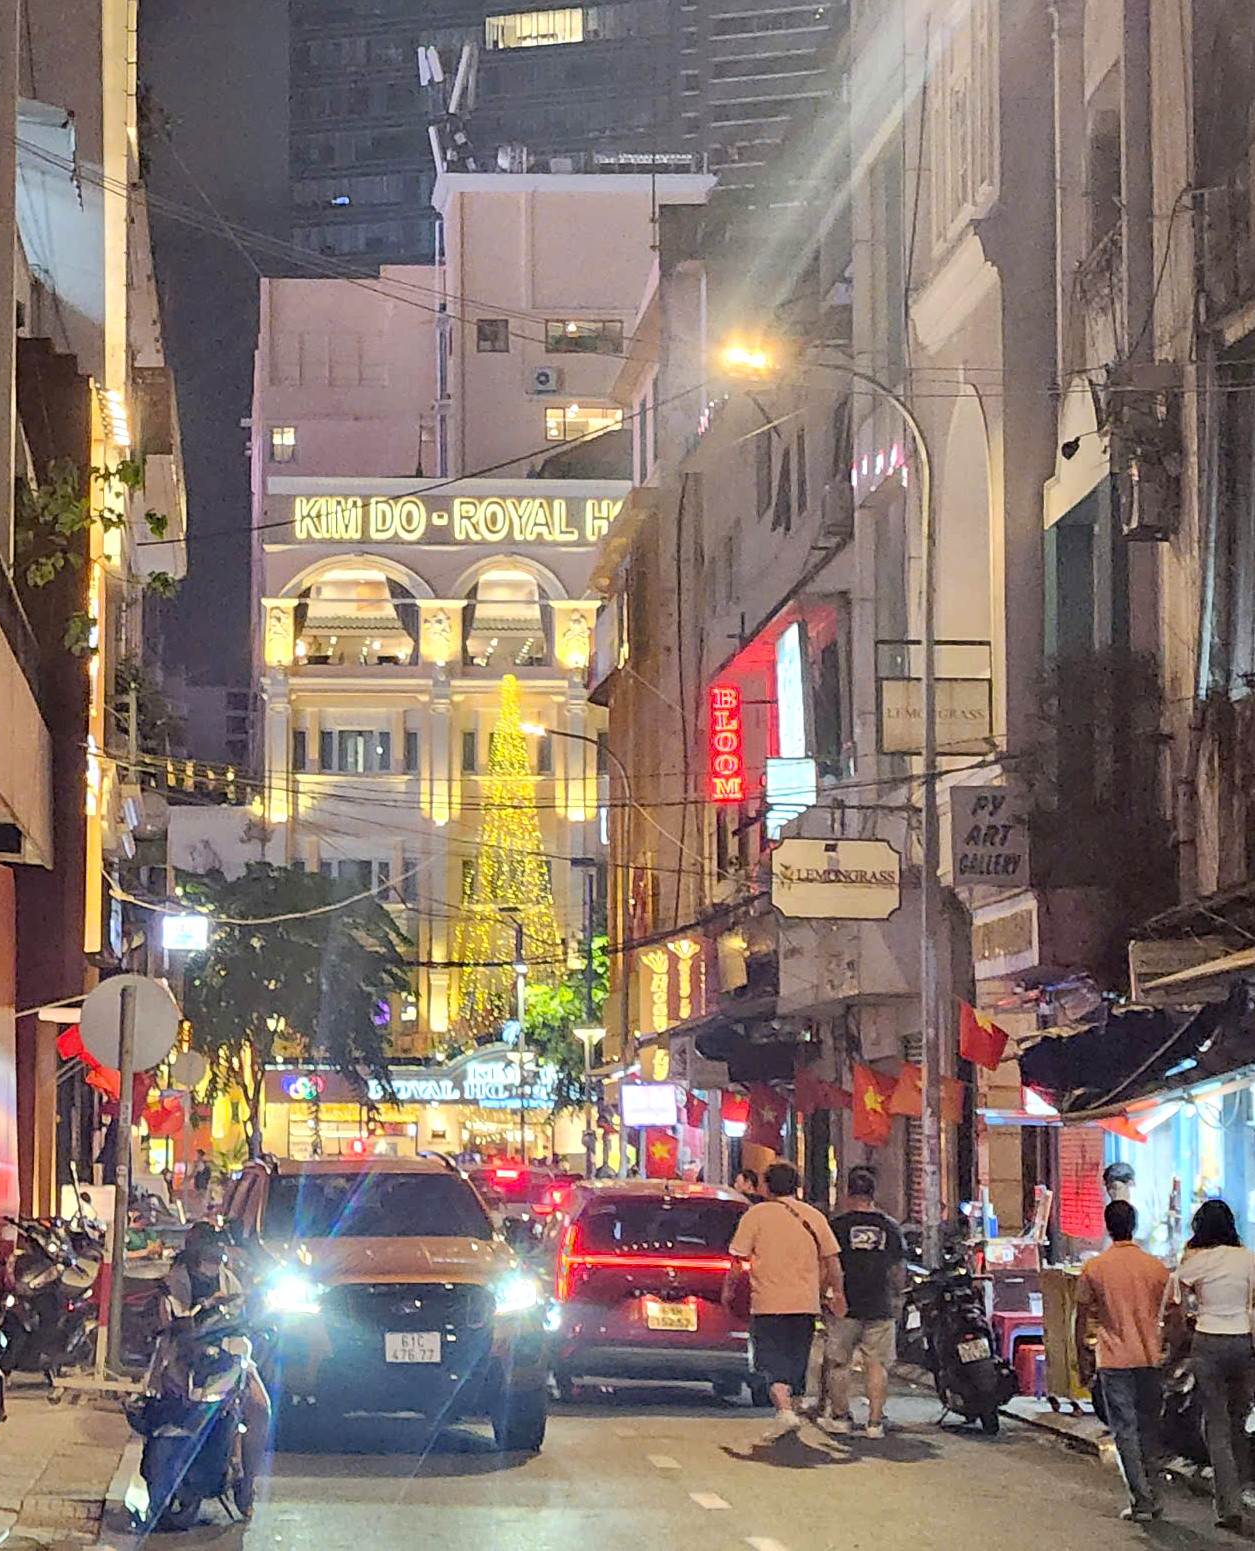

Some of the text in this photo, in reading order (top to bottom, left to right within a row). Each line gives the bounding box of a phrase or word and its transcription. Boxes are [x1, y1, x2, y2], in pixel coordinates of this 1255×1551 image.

[295, 497, 362, 540] KIM
[369, 497, 426, 540] DO
[454, 498, 578, 542] ROYAL
[712, 688, 742, 800] BLOOM
[971, 794, 1006, 817] PY
[964, 823, 1014, 847] ART
[796, 868, 896, 883] LEMONGRASS
[958, 852, 1022, 876] GALLERY
